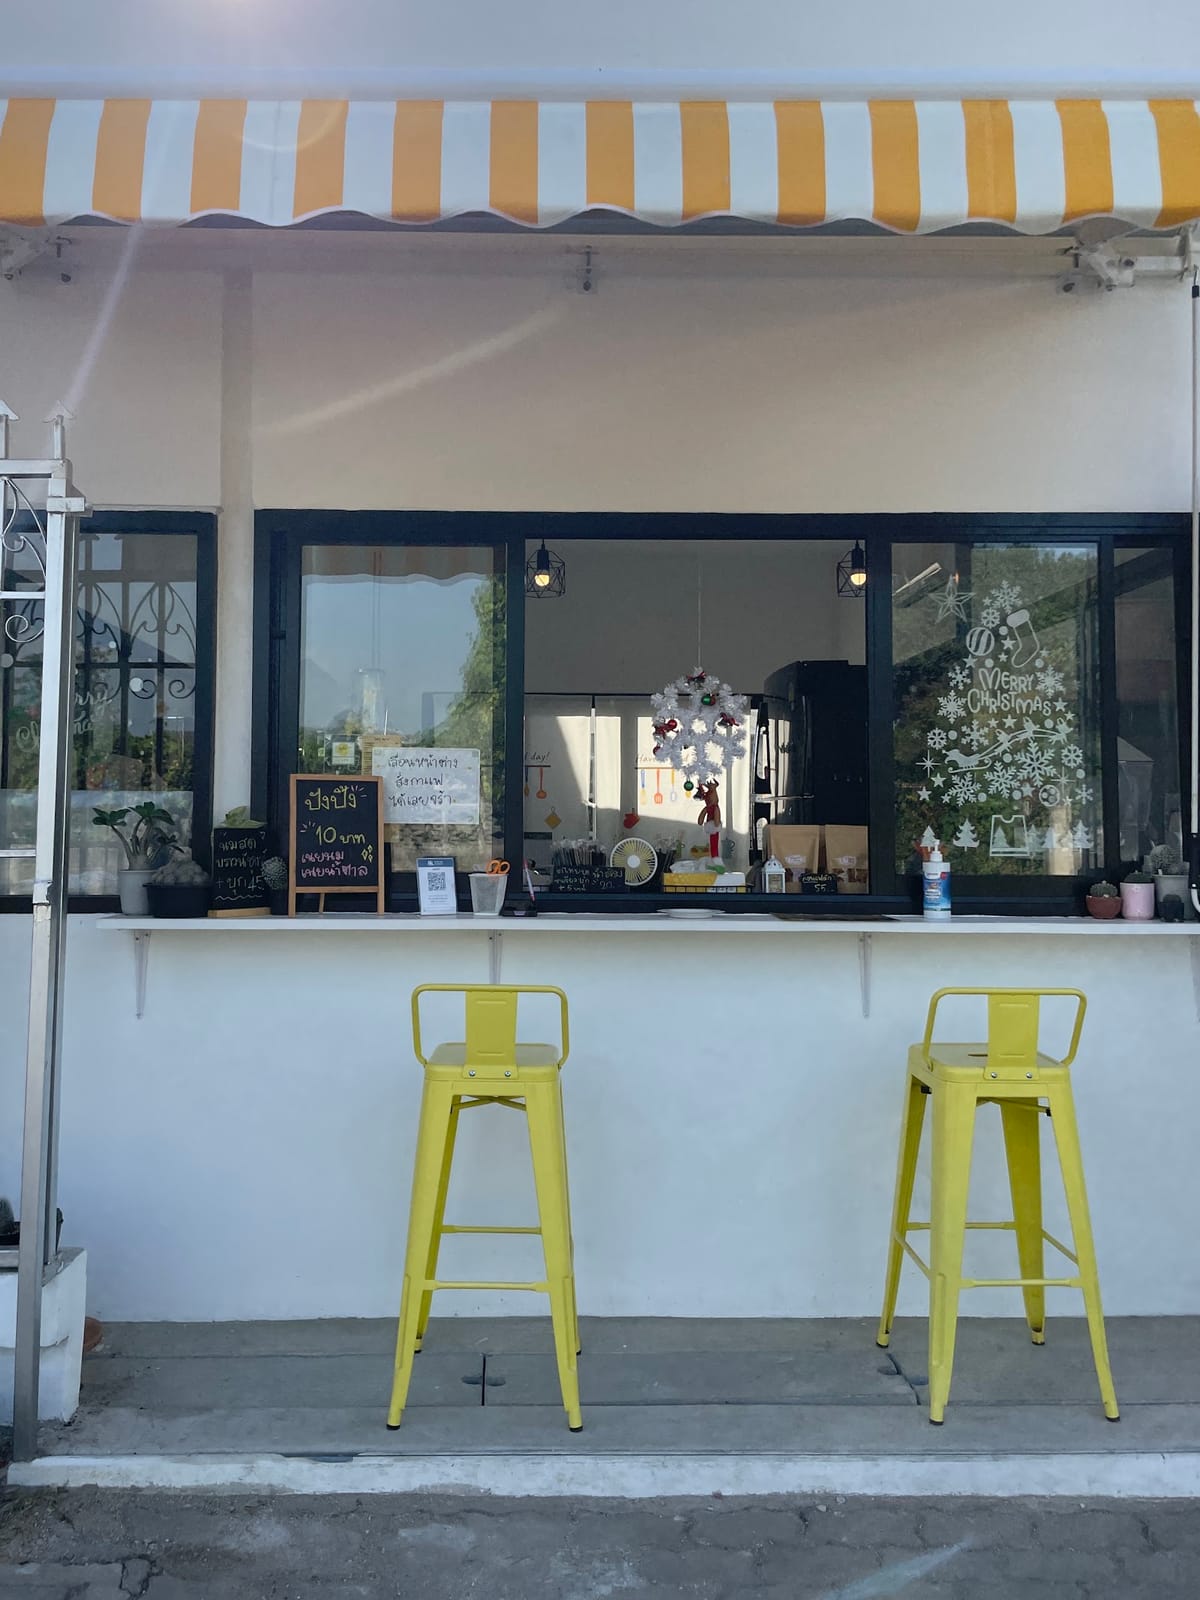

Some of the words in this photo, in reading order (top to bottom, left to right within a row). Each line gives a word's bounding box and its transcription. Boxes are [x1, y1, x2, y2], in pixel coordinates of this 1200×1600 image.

[978, 667, 1035, 694] MERRY
[967, 688, 1052, 717] CHRISTMAS
[315, 825, 337, 846] 10
[339, 833, 366, 845] บาท
